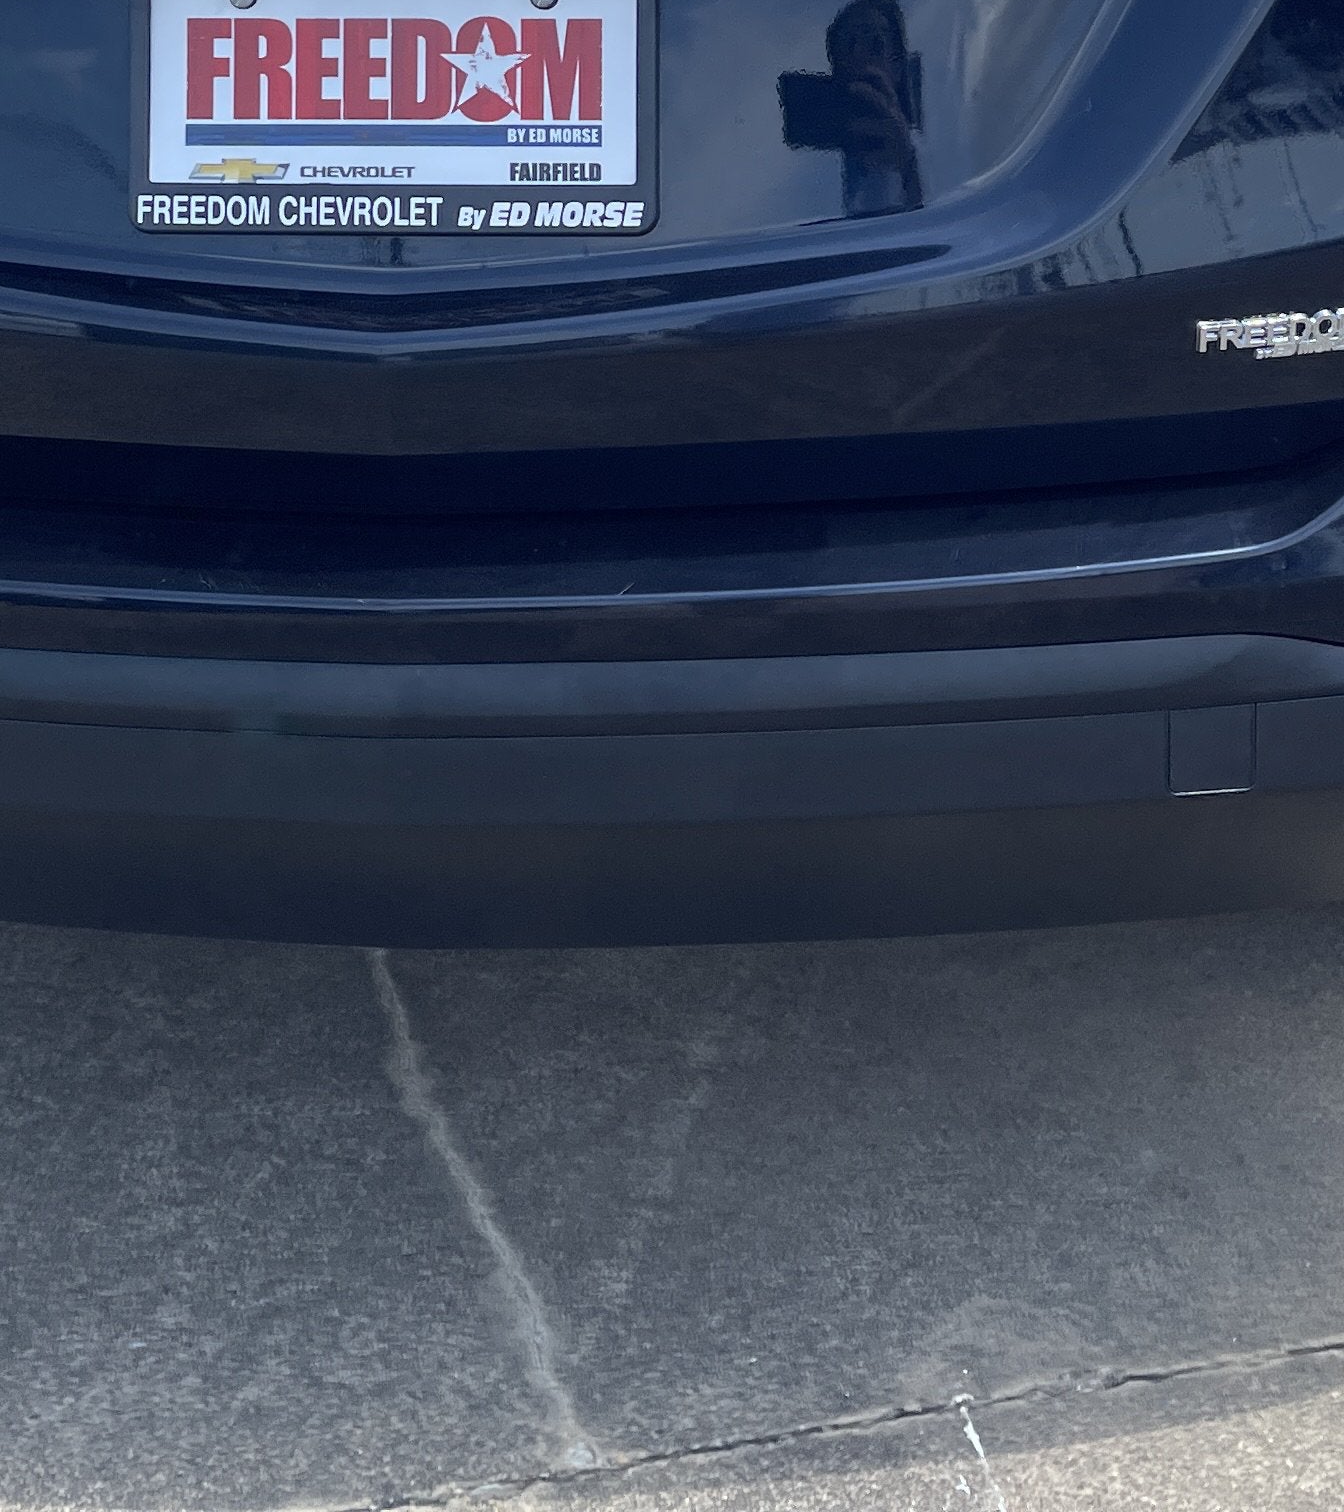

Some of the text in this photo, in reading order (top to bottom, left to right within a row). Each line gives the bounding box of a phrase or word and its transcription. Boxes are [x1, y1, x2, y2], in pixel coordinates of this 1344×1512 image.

[186, 16, 603, 122] FREEDOM
[507, 128, 599, 144] BY ED MORSE
[299, 165, 416, 179] CHEVROLET
[509, 162, 602, 182] FAIRFIELD
[137, 195, 645, 231] FREEDOM CHEVROLET By ED MORSE
